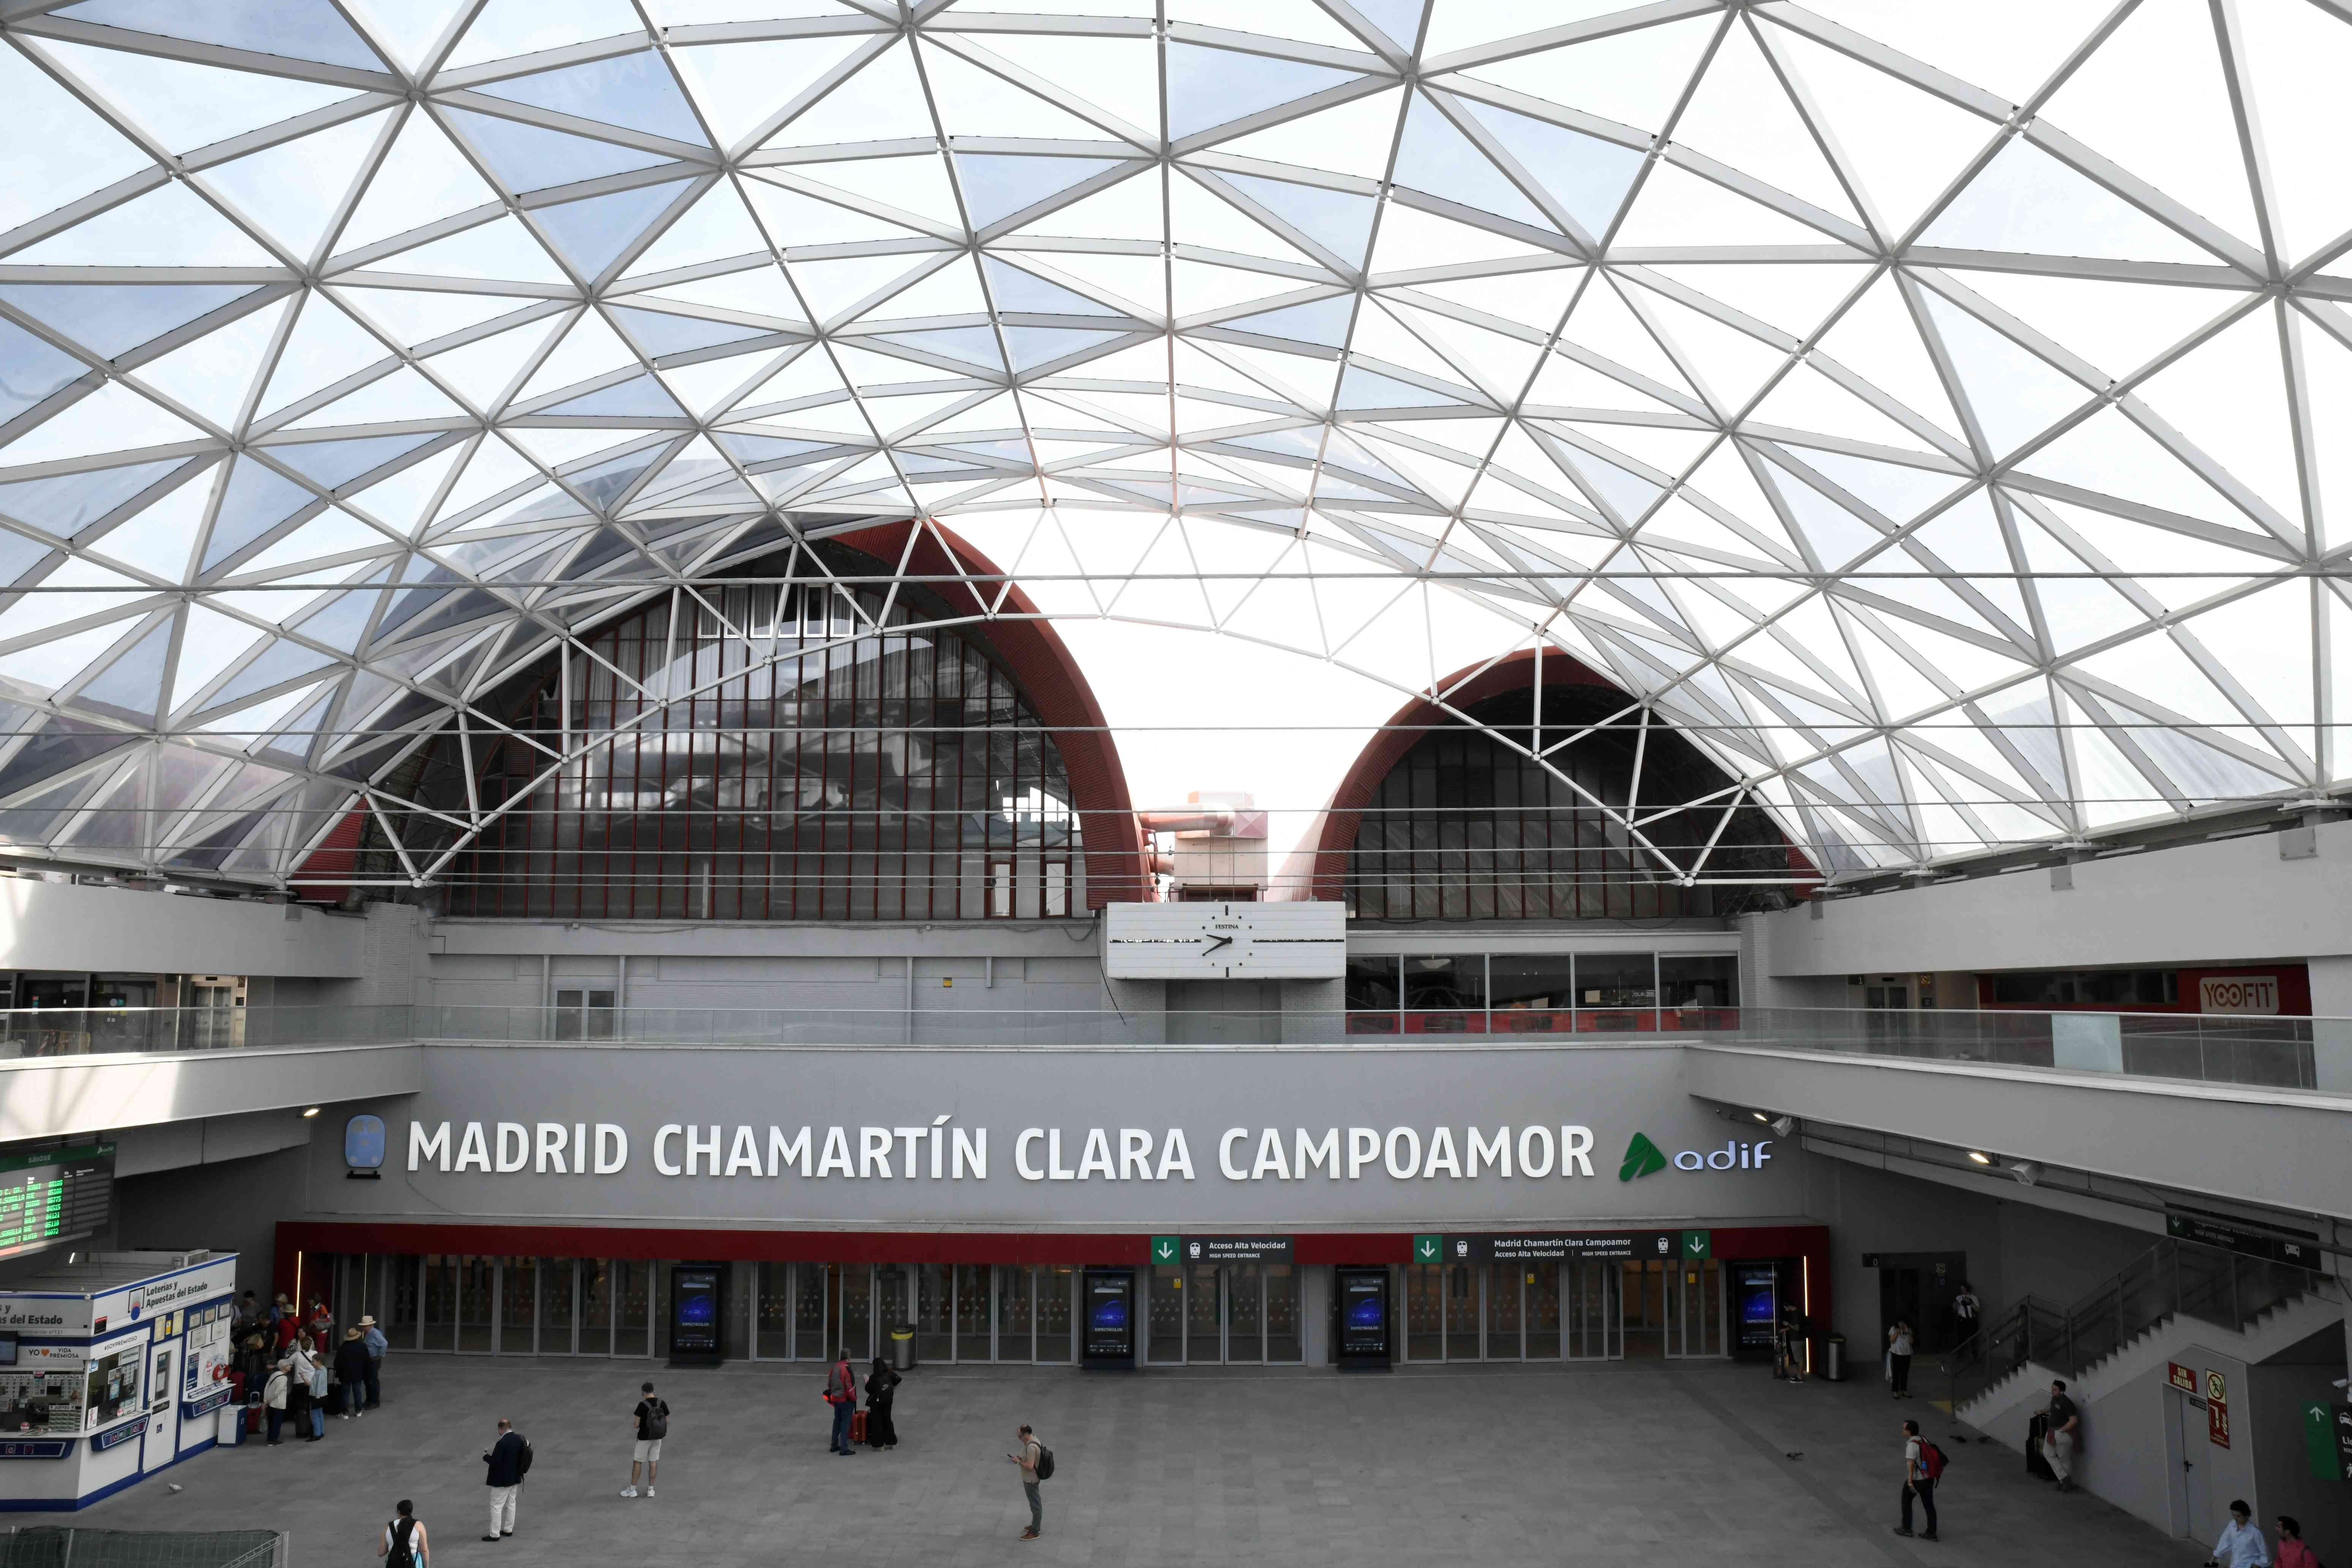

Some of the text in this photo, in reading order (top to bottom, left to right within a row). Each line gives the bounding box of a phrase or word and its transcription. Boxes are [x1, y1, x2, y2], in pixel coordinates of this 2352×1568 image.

[2203, 983, 2273, 1007] YOOFIT
[408, 1115, 1595, 1180] MADRID CHAMARTÍN CLARA CAMPOAMOR
[1673, 1141, 1773, 1171] adif
[1524, 1238, 1563, 1247] Chamartín
[1585, 1239, 1631, 1247] Campoamor
[146, 1283, 208, 1308] Apuestas del Estado
[147, 1281, 178, 1297] Loterías y
[5, 1305, 11, 1314] y
[10, 1315, 25, 1324] del
[28, 1315, 63, 1325] Estado
[104, 1336, 138, 1350] #SOYPREMIOSO
[2177, 1367, 2187, 1378] SIN
[2173, 1375, 2192, 1390] SALIDA
